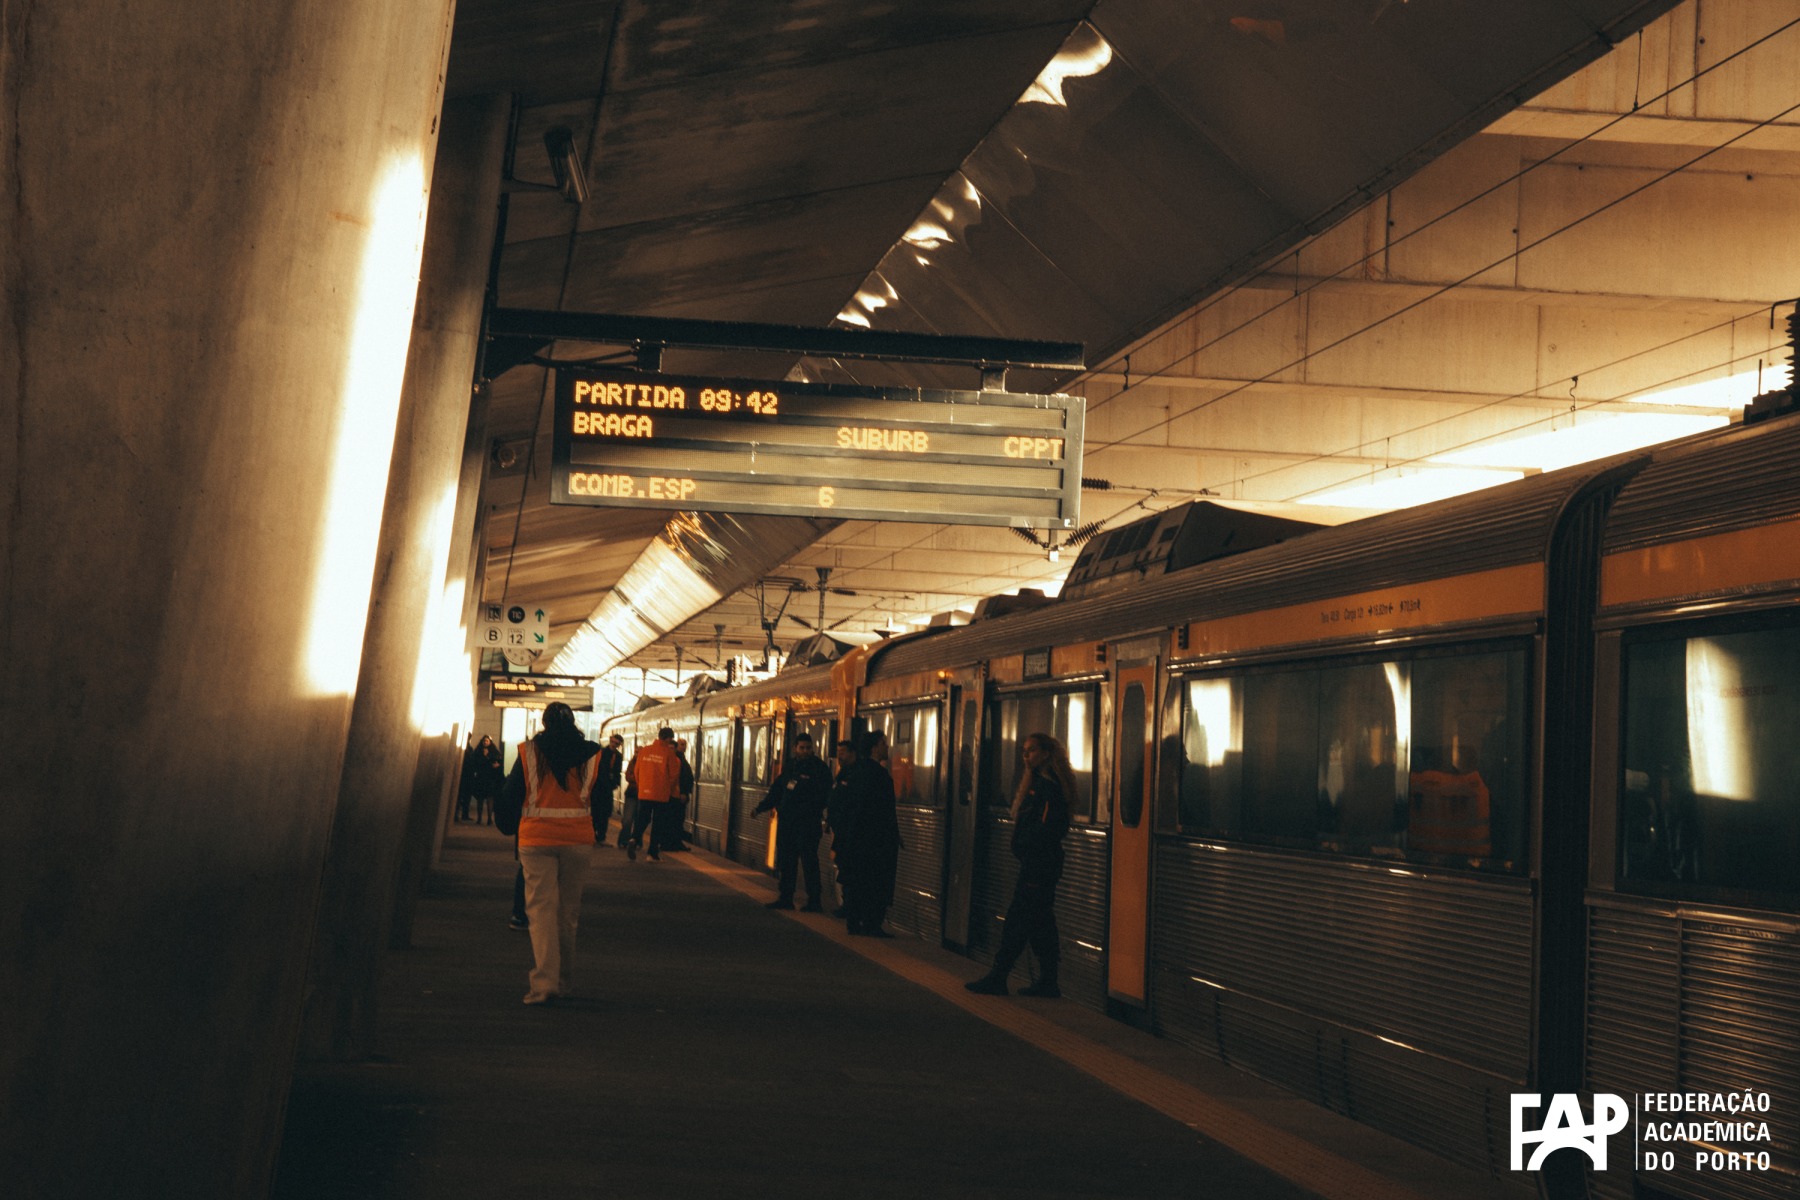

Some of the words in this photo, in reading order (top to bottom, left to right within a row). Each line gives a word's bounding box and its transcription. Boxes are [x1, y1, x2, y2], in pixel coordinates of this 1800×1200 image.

[575, 381, 685, 409] PARTIDA
[700, 388, 778, 415] 09:42
[573, 411, 653, 438] BRAGA
[837, 427, 929, 453] SUBURB
[1004, 436, 1063, 460] CPPT
[571, 472, 697, 500] COMB.ESP
[818, 486, 834, 508] 6
[489, 629, 498, 641] B
[509, 633, 523, 645] 12
